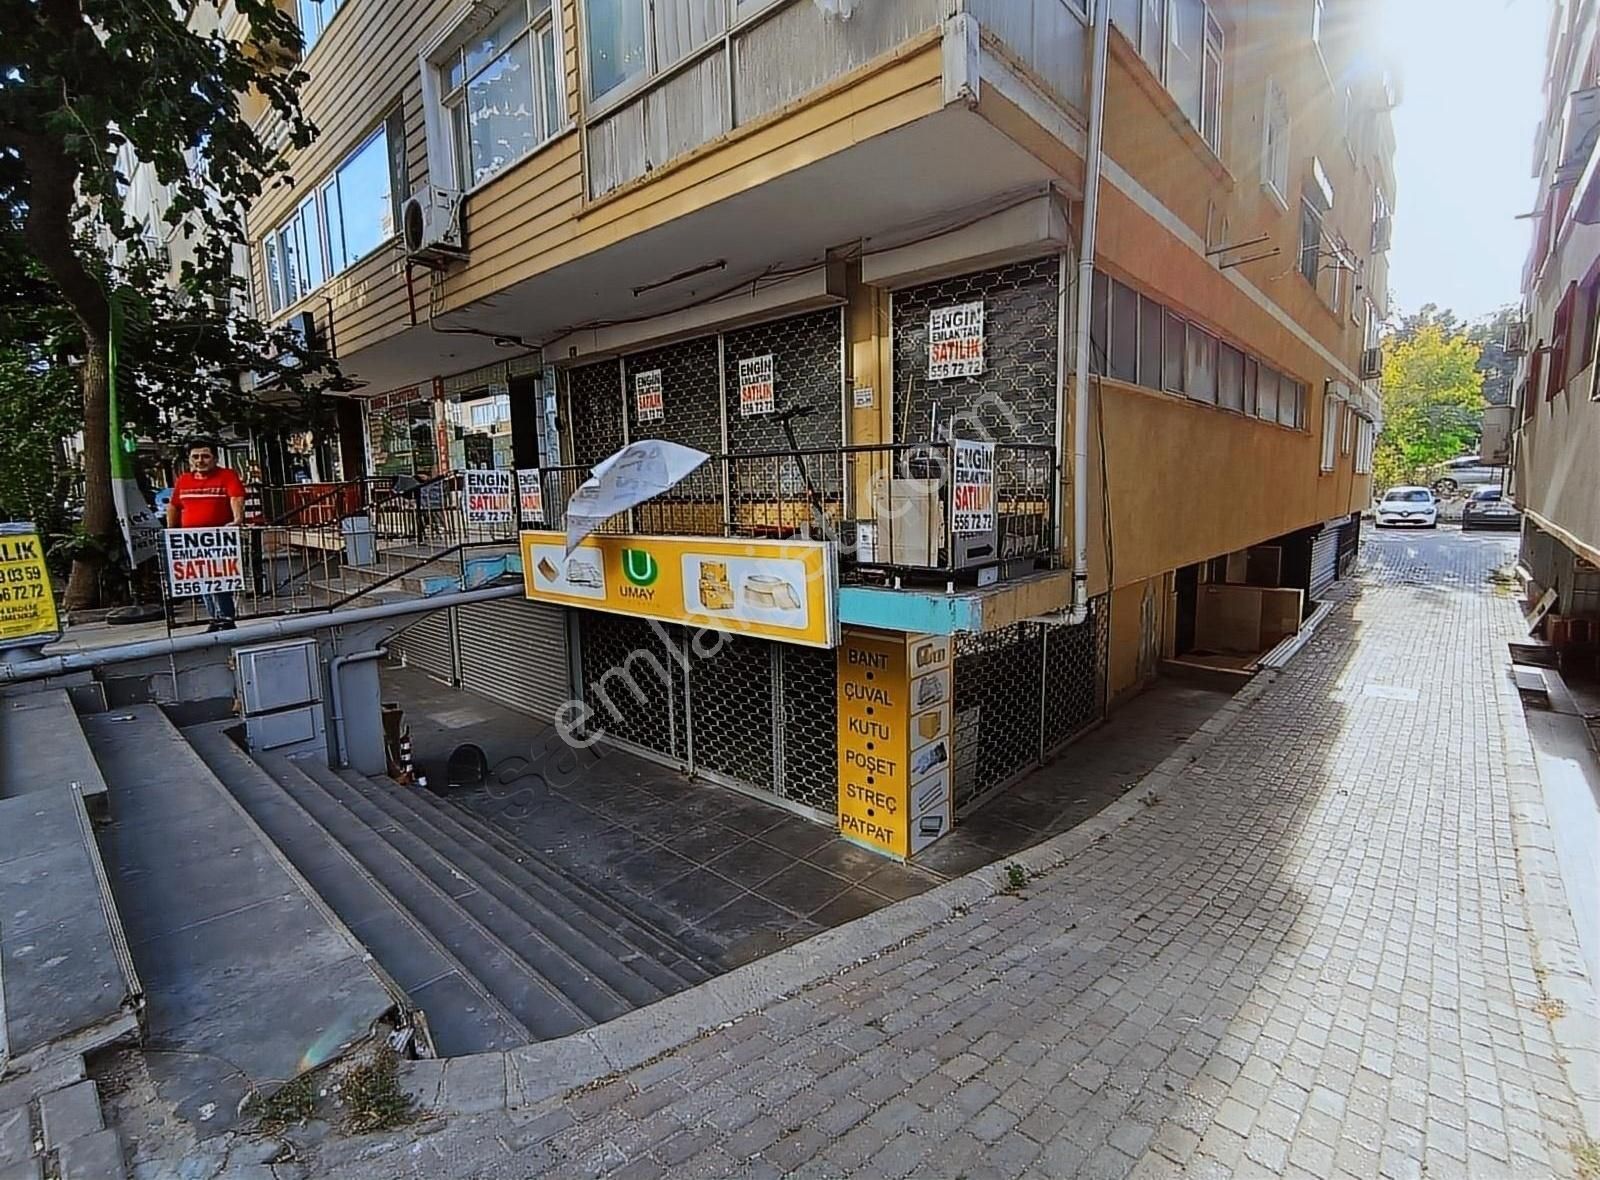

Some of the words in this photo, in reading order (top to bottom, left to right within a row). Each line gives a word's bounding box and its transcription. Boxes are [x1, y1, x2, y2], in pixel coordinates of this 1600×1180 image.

[932, 339, 980, 362] SATILIK
[952, 362, 965, 375] 72
[967, 360, 980, 374] 72
[168, 528, 237, 549] ENGİN
[24, 566, 41, 580] 59
[173, 558, 240, 581] SATILIK
[12, 585, 28, 600] 72
[29, 583, 45, 598] 72
[174, 582, 201, 595] 556
[204, 580, 222, 592] 72
[225, 578, 242, 591] 72
[619, 585, 655, 600] UMAY
[848, 649, 889, 670] BANT
[844, 682, 893, 706] ÇUVAL
[849, 716, 889, 741] KUTU
[846, 749, 897, 777] POŞET
[846, 783, 897, 815] STREÇ
[841, 813, 894, 845] PATPAT
